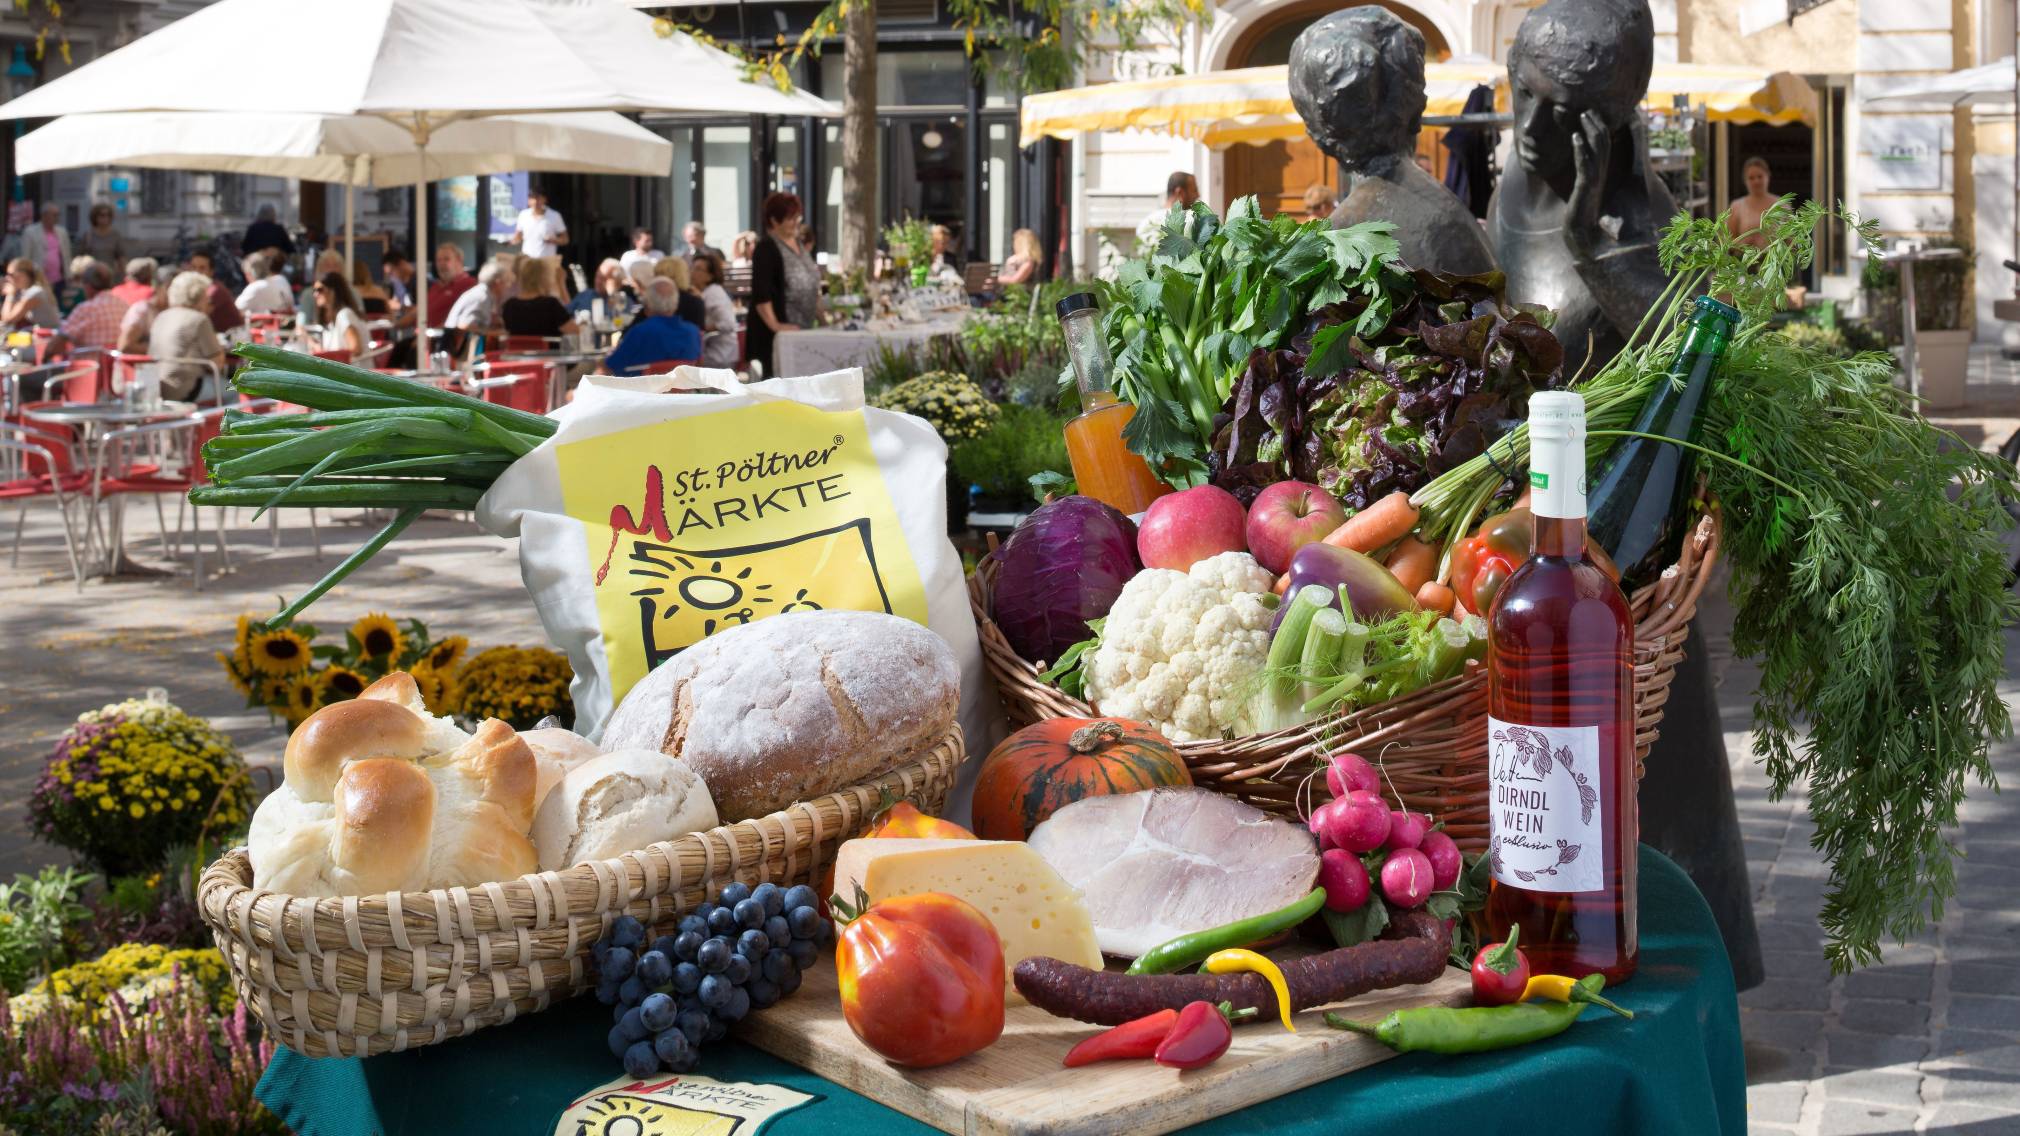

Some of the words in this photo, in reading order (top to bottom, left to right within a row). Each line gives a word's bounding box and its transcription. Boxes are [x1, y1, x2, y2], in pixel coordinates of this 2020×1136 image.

[595, 464, 852, 586] MÄRKTE
[1498, 784, 1551, 811] DIRNDL
[1503, 809, 1544, 834] WEIN
